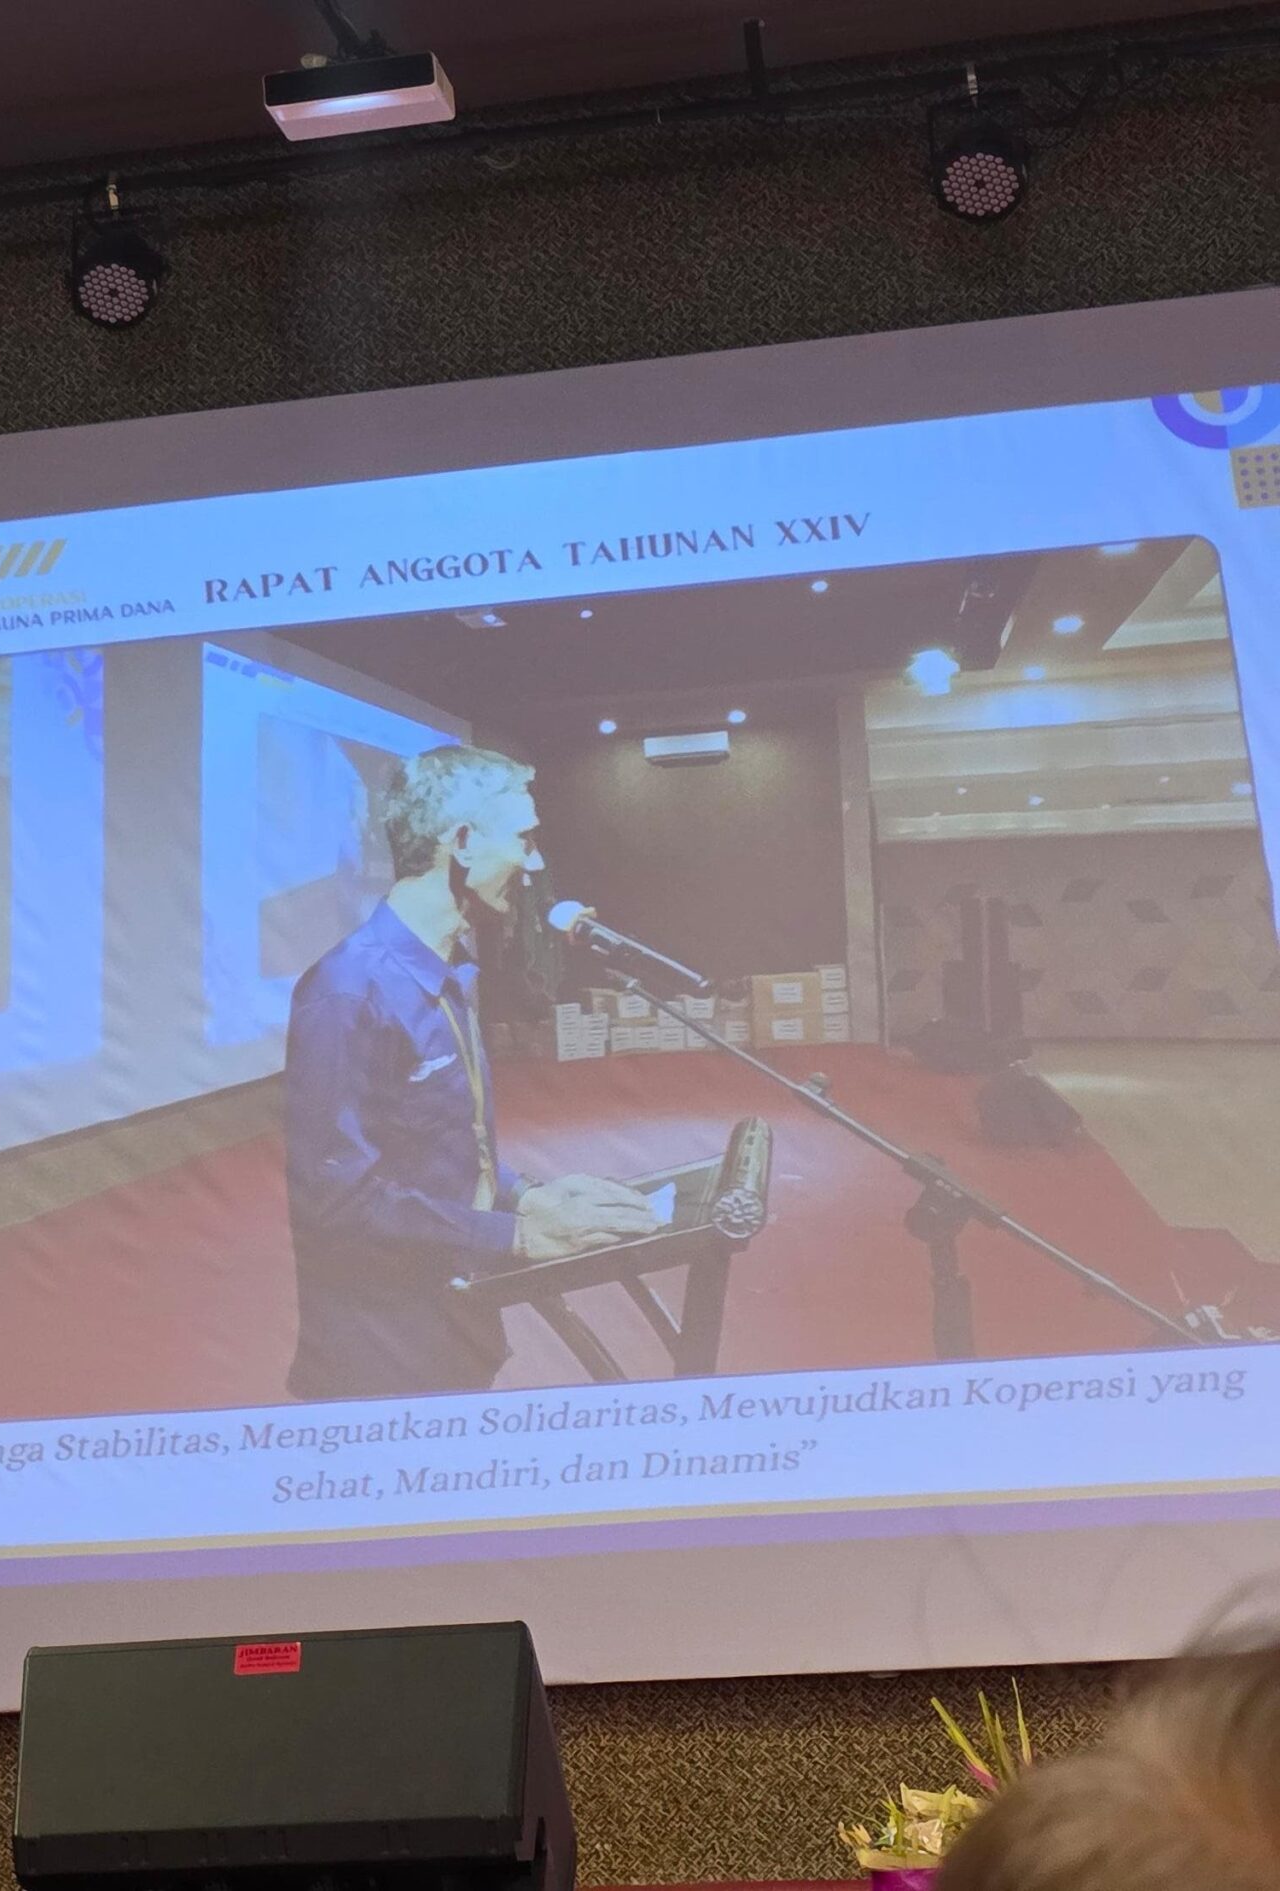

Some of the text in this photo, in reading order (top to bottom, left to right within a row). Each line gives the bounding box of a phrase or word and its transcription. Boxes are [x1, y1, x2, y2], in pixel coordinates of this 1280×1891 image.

[203, 511, 872, 604] RAPAT ANGGOTA TAHUNAN XXIV
[50, 606, 114, 626] PRIMA
[120, 598, 176, 618] DANA
[54, 1427, 231, 1462] Stabilitas,
[238, 1411, 468, 1454] Menguatkan
[478, 1396, 690, 1436] Solidaritas,
[697, 1380, 951, 1424] Mewujudkan
[962, 1367, 1137, 1412] Koperasi
[1145, 1367, 1248, 1404] yang
[271, 1470, 384, 1504] Sehat,
[392, 1457, 551, 1497] Mandiri,
[560, 1453, 629, 1486] dan
